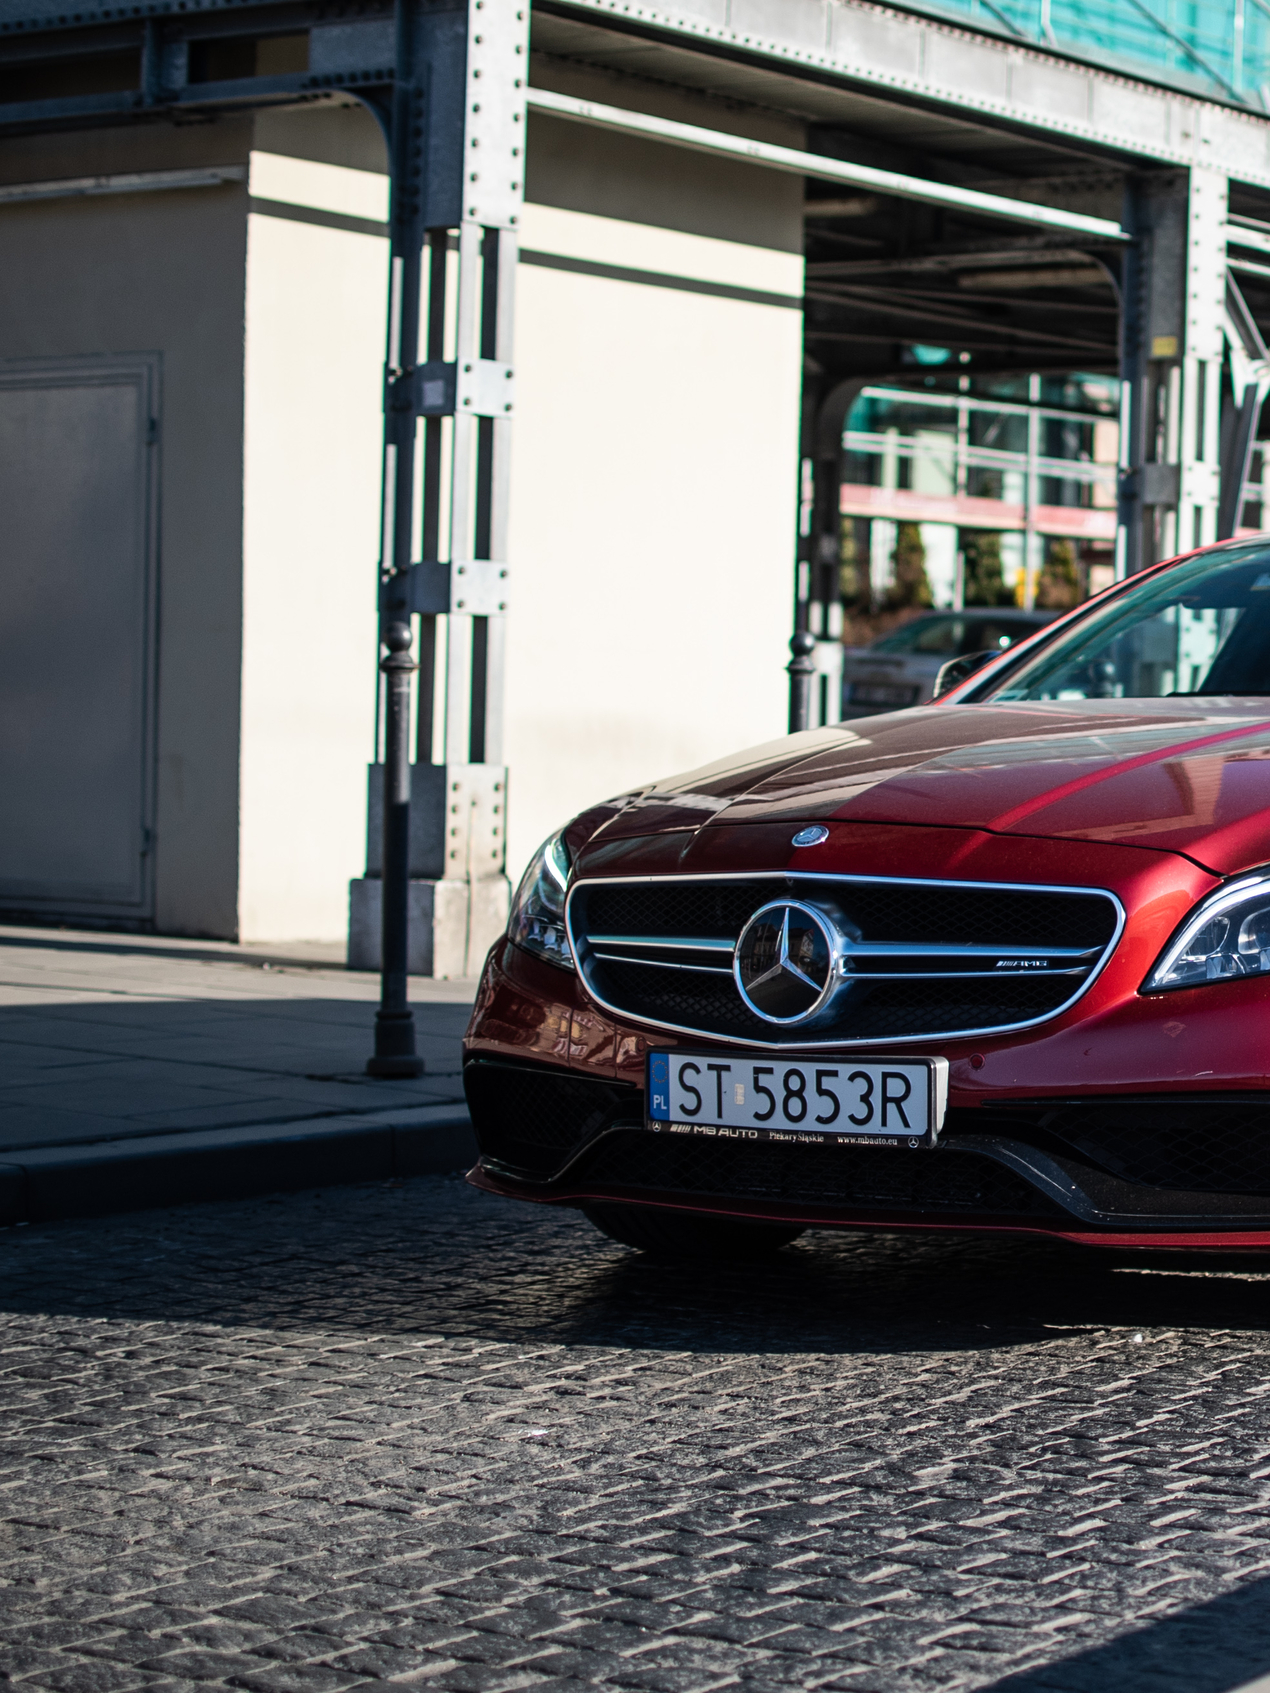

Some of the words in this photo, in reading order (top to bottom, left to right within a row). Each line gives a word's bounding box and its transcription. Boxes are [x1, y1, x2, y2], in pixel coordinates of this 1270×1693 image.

[1012, 960, 1048, 968] AMG
[678, 1061, 732, 1119] ST
[752, 1066, 912, 1129] 5853R
[653, 1094, 668, 1110] PL
[693, 1125, 717, 1136] MB
[717, 1128, 759, 1139] AUTO
[768, 1131, 797, 1143] Piekary
[837, 1135, 898, 1146] www.mbauto.eu
